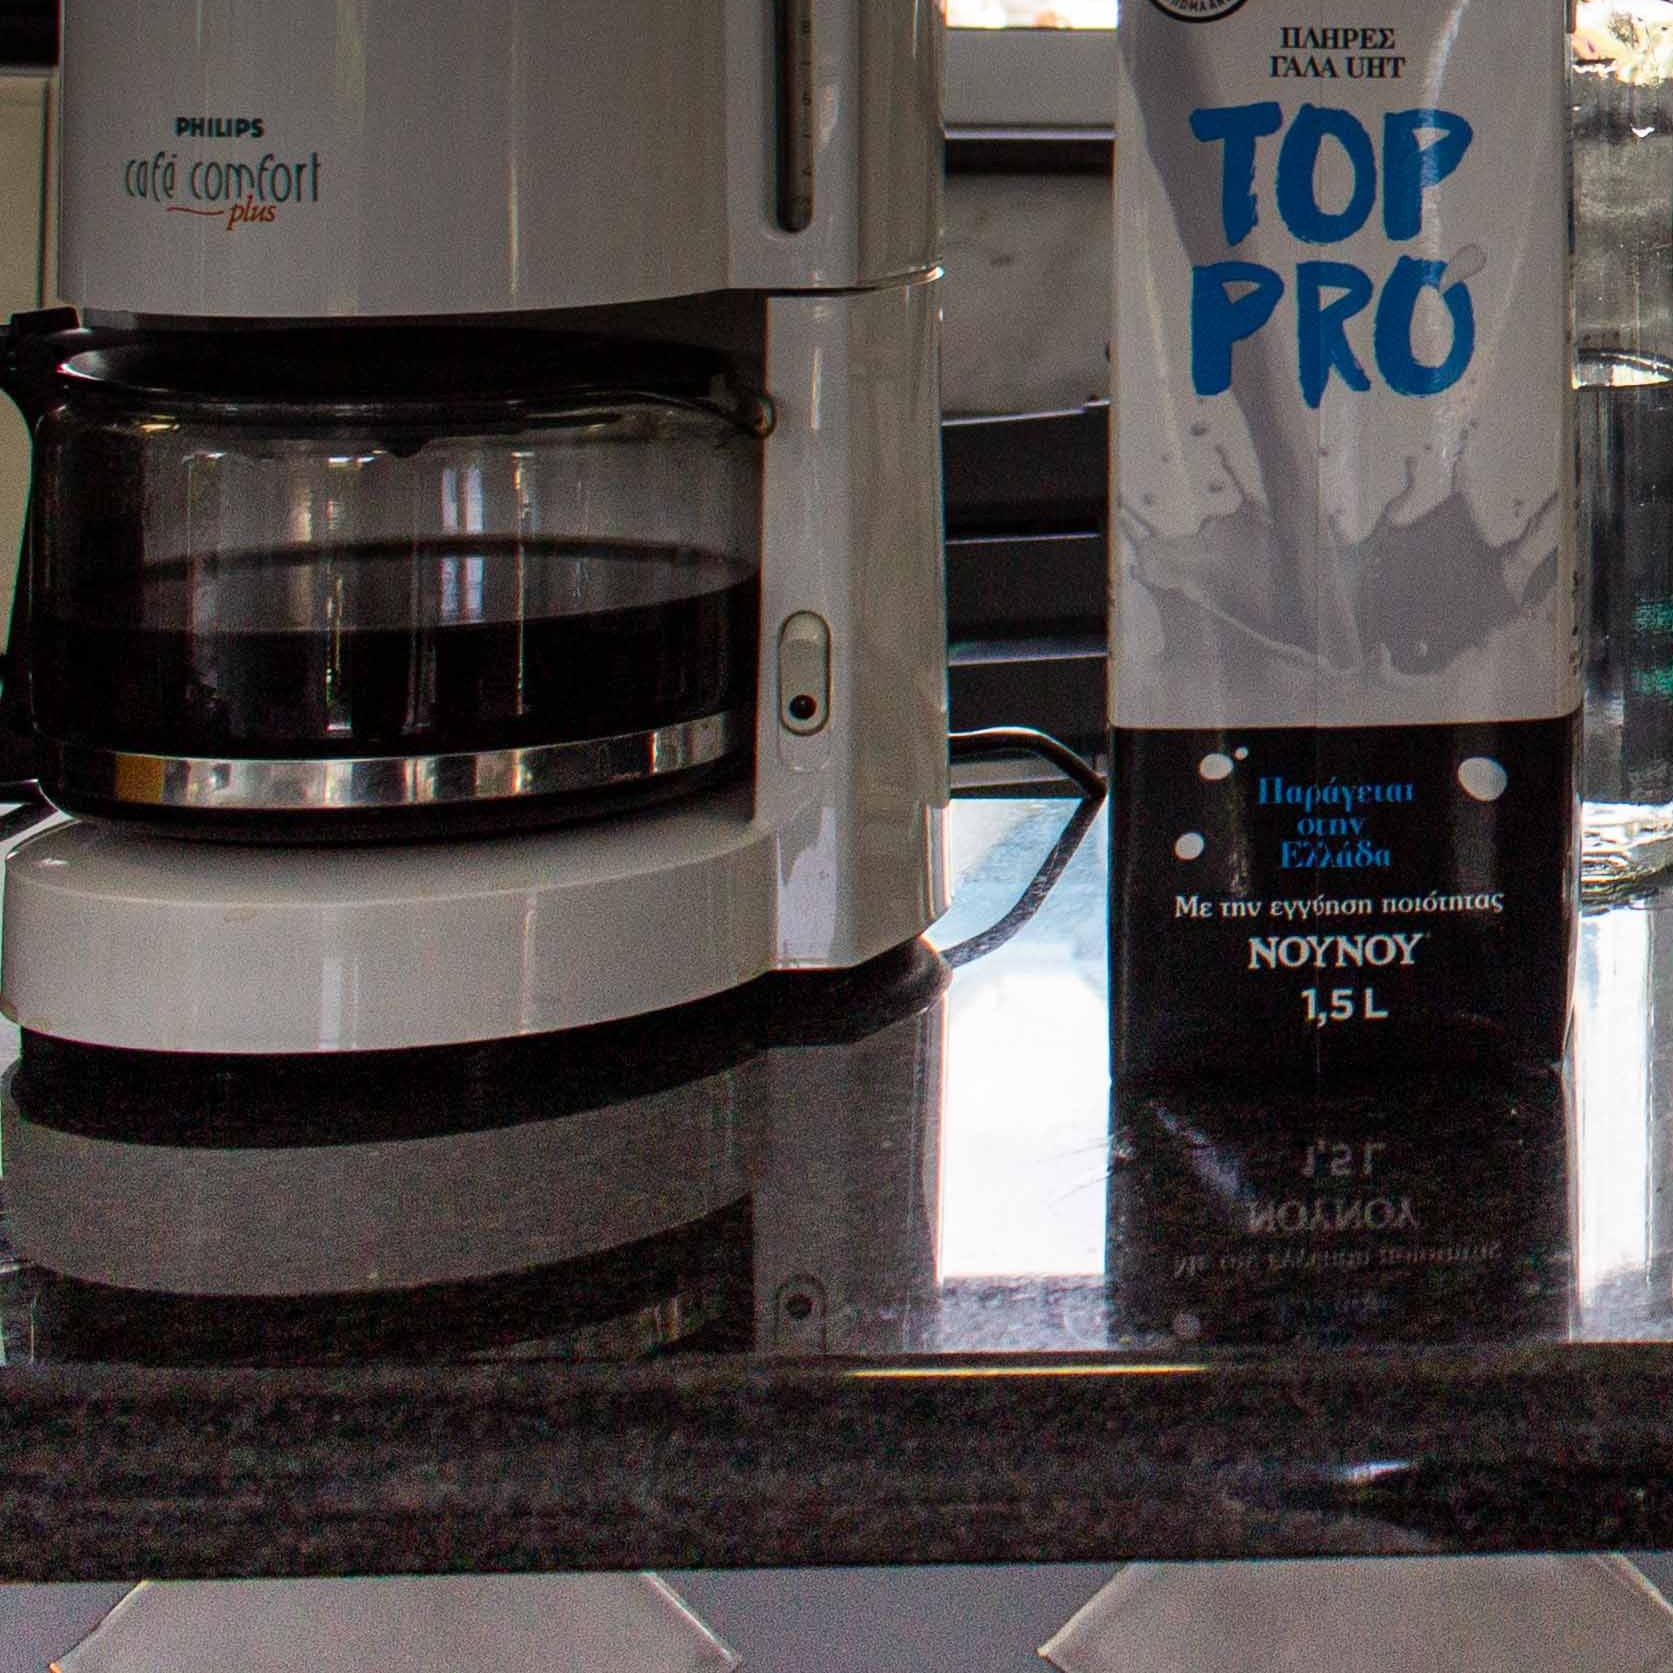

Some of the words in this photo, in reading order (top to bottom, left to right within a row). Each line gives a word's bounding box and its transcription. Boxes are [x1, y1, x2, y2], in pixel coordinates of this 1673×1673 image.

[1280, 27, 1395, 49] ΠΛΗΡΕΣ
[1269, 55, 1338, 78] ΓΑΛΑ
[1346, 56, 1406, 78] UHT
[175, 117, 265, 138] PHILIPS
[189, 151, 321, 202] comfort
[1189, 100, 1473, 246] TOP
[225, 195, 276, 231] plus
[1191, 255, 1475, 408] PRO
[1257, 774, 1415, 812] Παράγεται
[1297, 816, 1368, 837] στην
[1280, 838, 1391, 869] Ελλάδα
[1175, 895, 1213, 918] Με
[1221, 898, 1262, 918] την
[1270, 893, 1372, 922] εγγύηση
[1381, 889, 1505, 914] ποιότητας
[1247, 932, 1425, 970] ΝΟΥΝΟΥ
[1301, 988, 1353, 1027] 1,5
